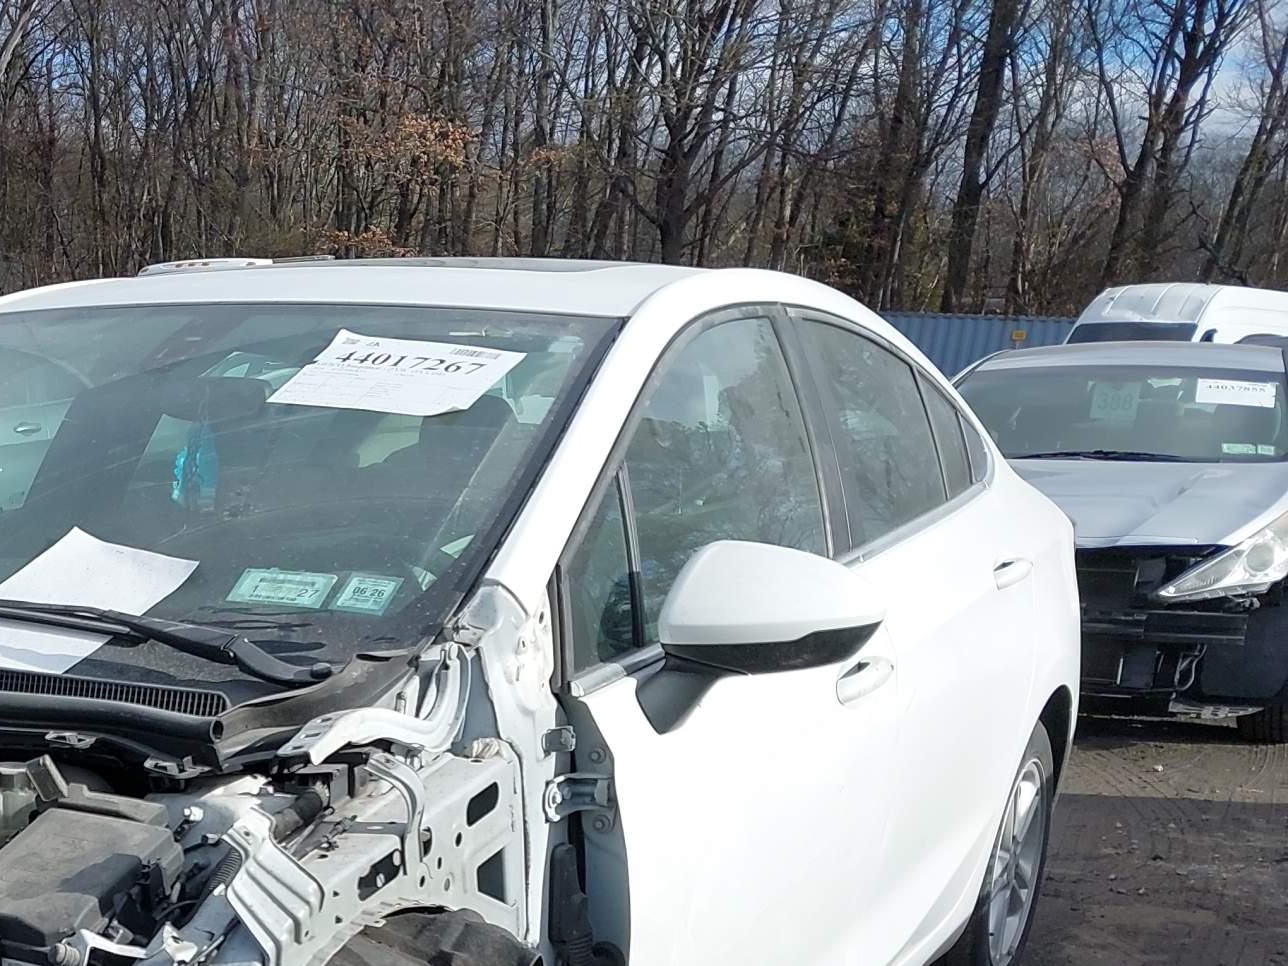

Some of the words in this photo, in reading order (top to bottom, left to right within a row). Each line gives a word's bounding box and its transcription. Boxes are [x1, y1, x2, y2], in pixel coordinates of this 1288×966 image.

[335, 350, 488, 375] 44017267
[297, 588, 320, 598] 27
[369, 588, 386, 598] 26
